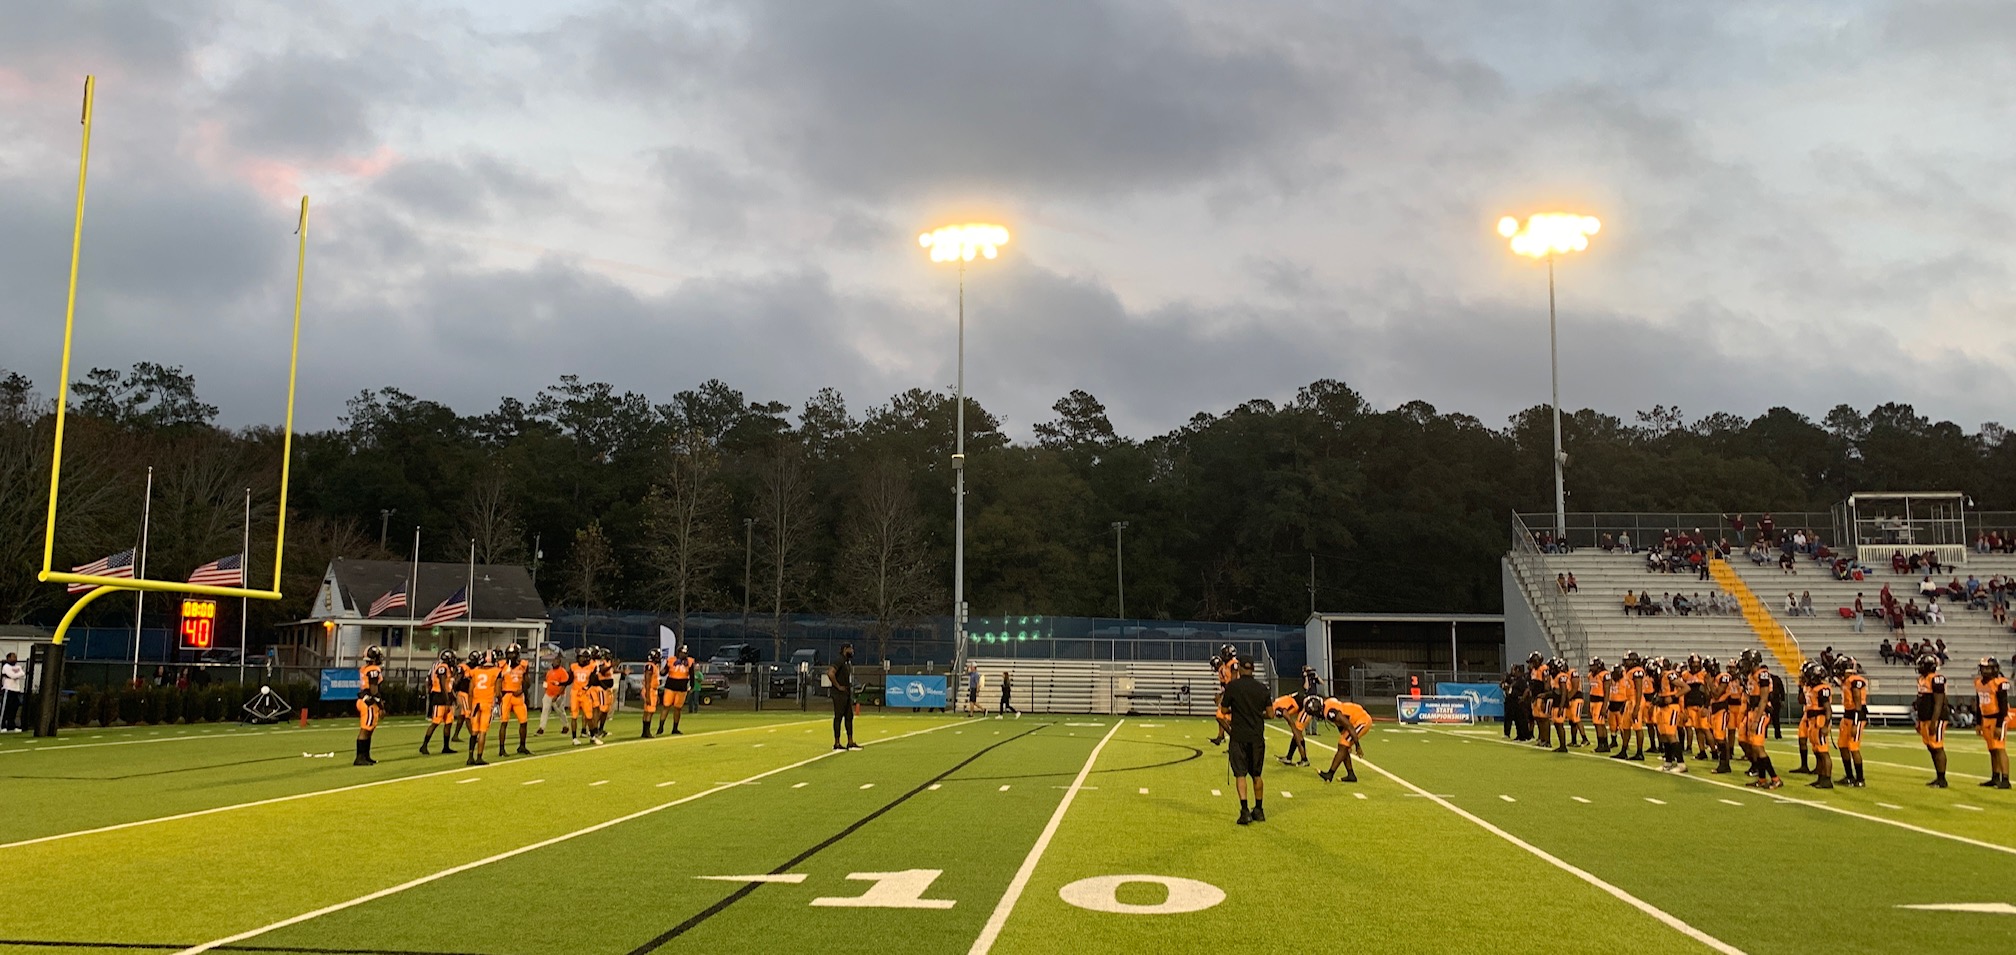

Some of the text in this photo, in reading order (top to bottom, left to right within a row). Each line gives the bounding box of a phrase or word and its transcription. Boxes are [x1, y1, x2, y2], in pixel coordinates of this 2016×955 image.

[184, 601, 214, 618] 08:00
[186, 619, 209, 646] 40
[476, 673, 488, 690] 2
[1411, 675, 1418, 686] 3
